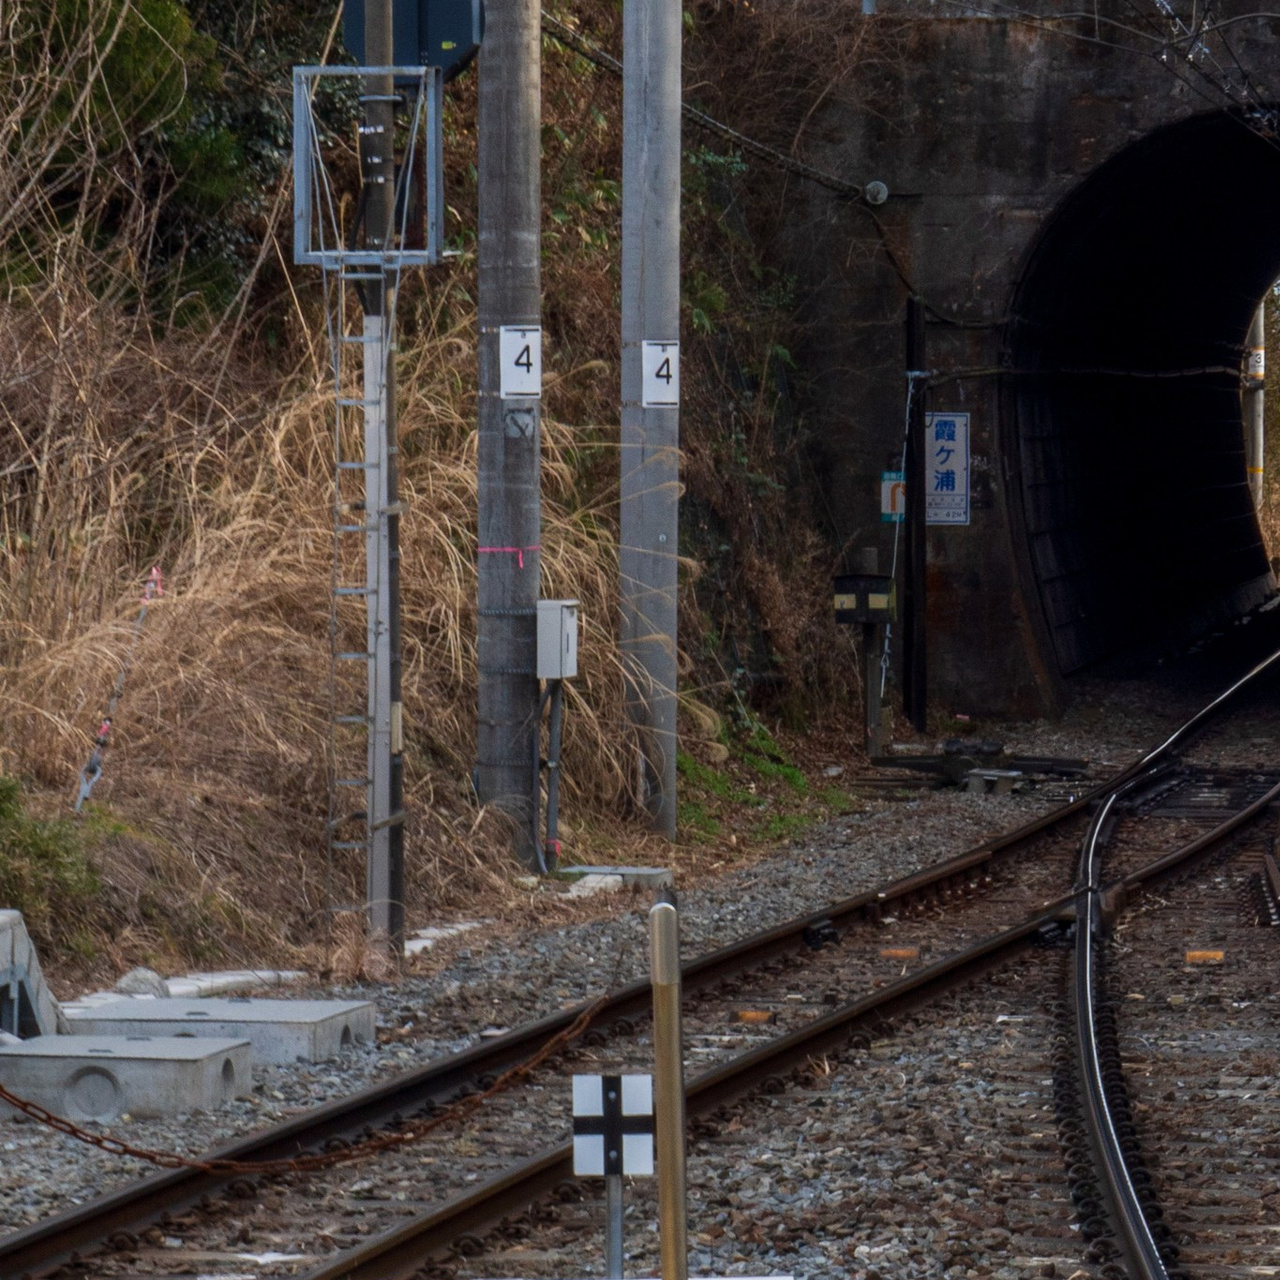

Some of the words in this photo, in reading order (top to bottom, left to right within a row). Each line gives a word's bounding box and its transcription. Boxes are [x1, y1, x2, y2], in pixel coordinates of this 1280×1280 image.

[514, 344, 533, 374] 4
[655, 356, 672, 385] 4
[1255, 353, 1262, 364] 3
